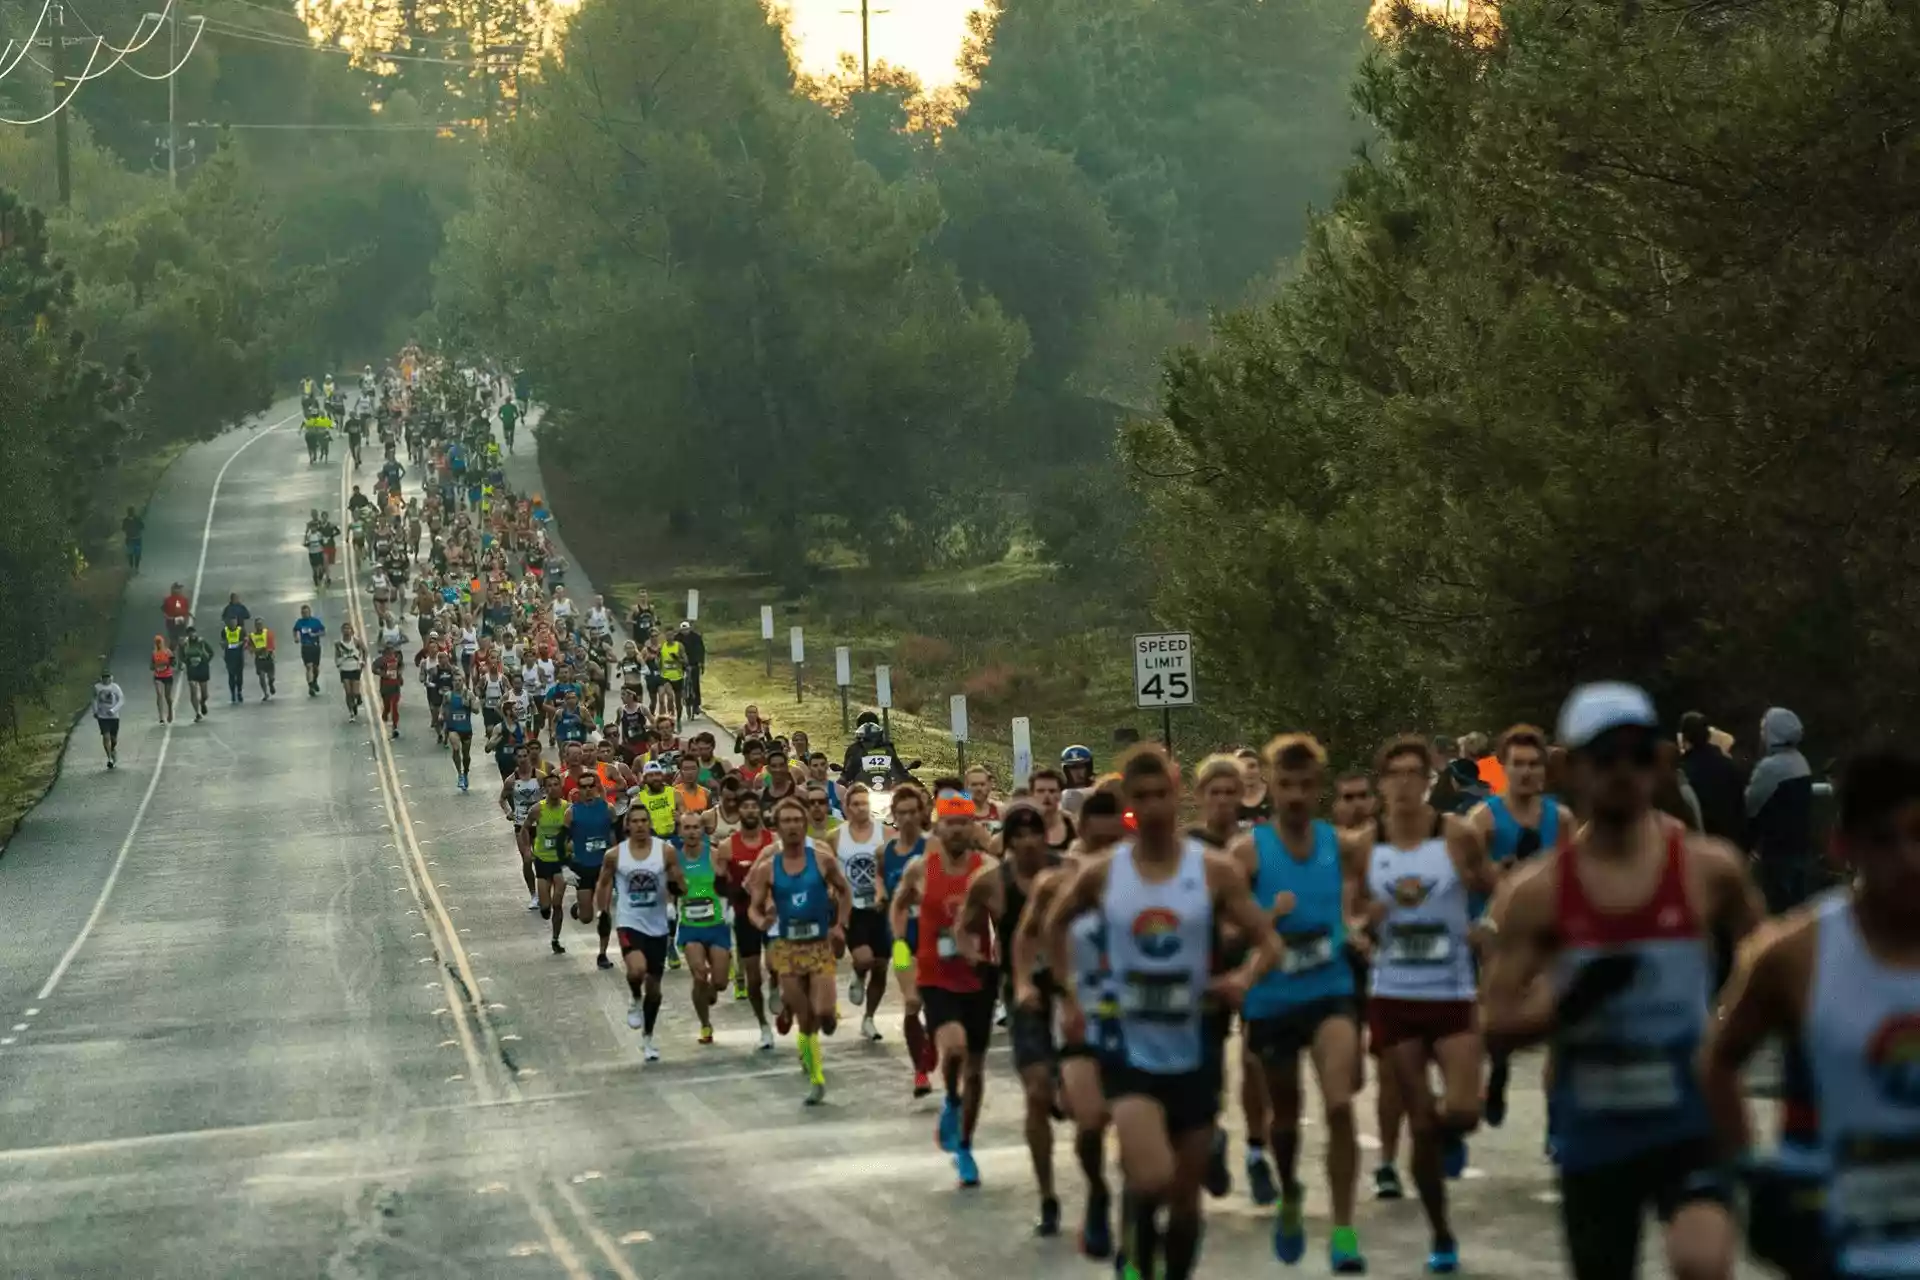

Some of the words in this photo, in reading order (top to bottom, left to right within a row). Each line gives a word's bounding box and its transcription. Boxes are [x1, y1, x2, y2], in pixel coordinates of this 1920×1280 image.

[1139, 640, 1188, 653] SPEED
[1145, 656, 1184, 669] LIMIT
[1141, 672, 1189, 700] 45
[868, 757, 885, 766] 42
